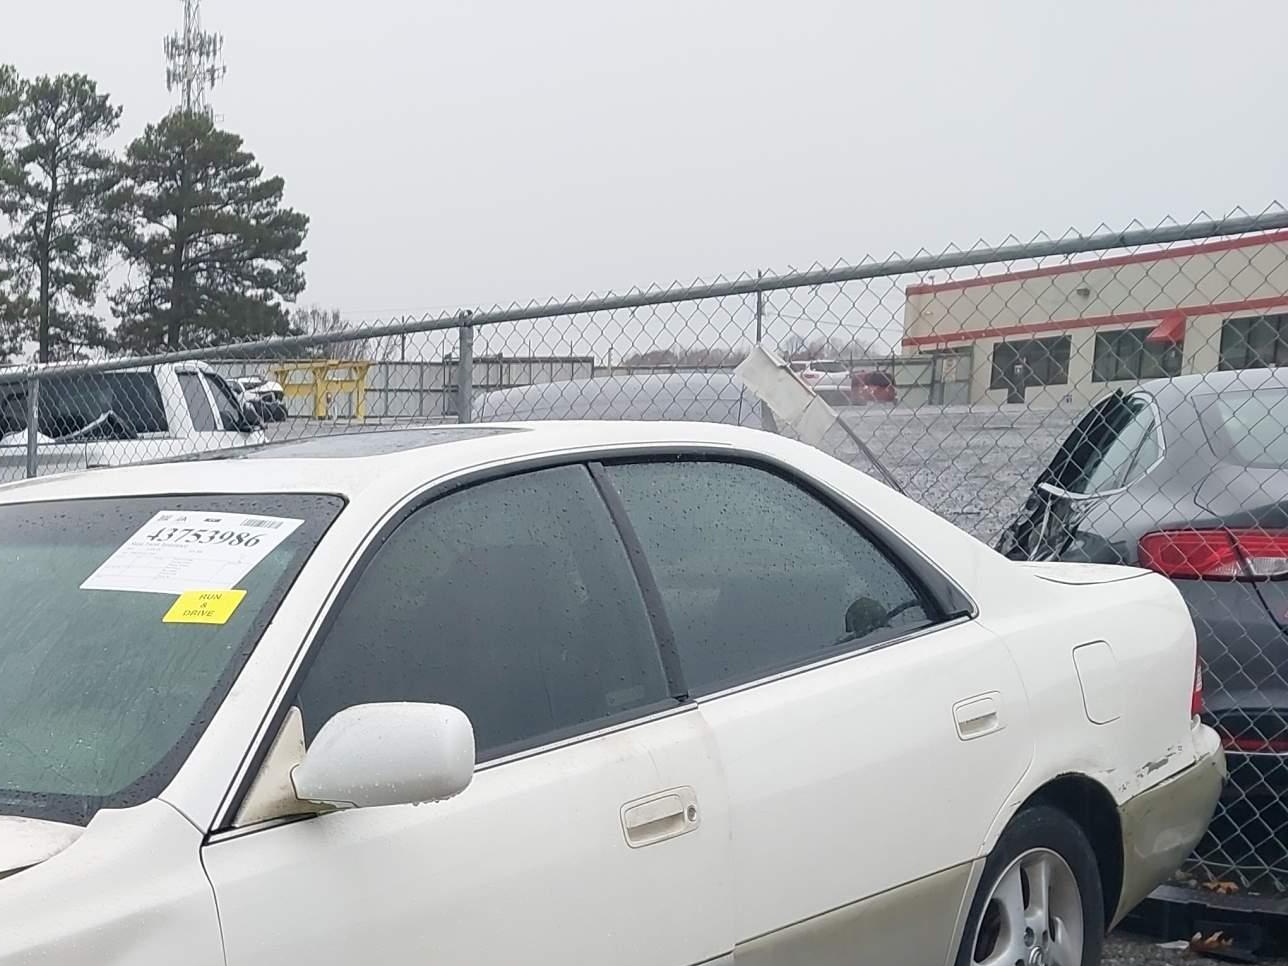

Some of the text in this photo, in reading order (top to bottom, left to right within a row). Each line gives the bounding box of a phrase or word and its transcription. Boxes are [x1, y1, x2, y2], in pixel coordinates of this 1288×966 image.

[147, 527, 264, 547] 43753986
[198, 593, 223, 601] RUN
[182, 609, 215, 617] DRIVE
